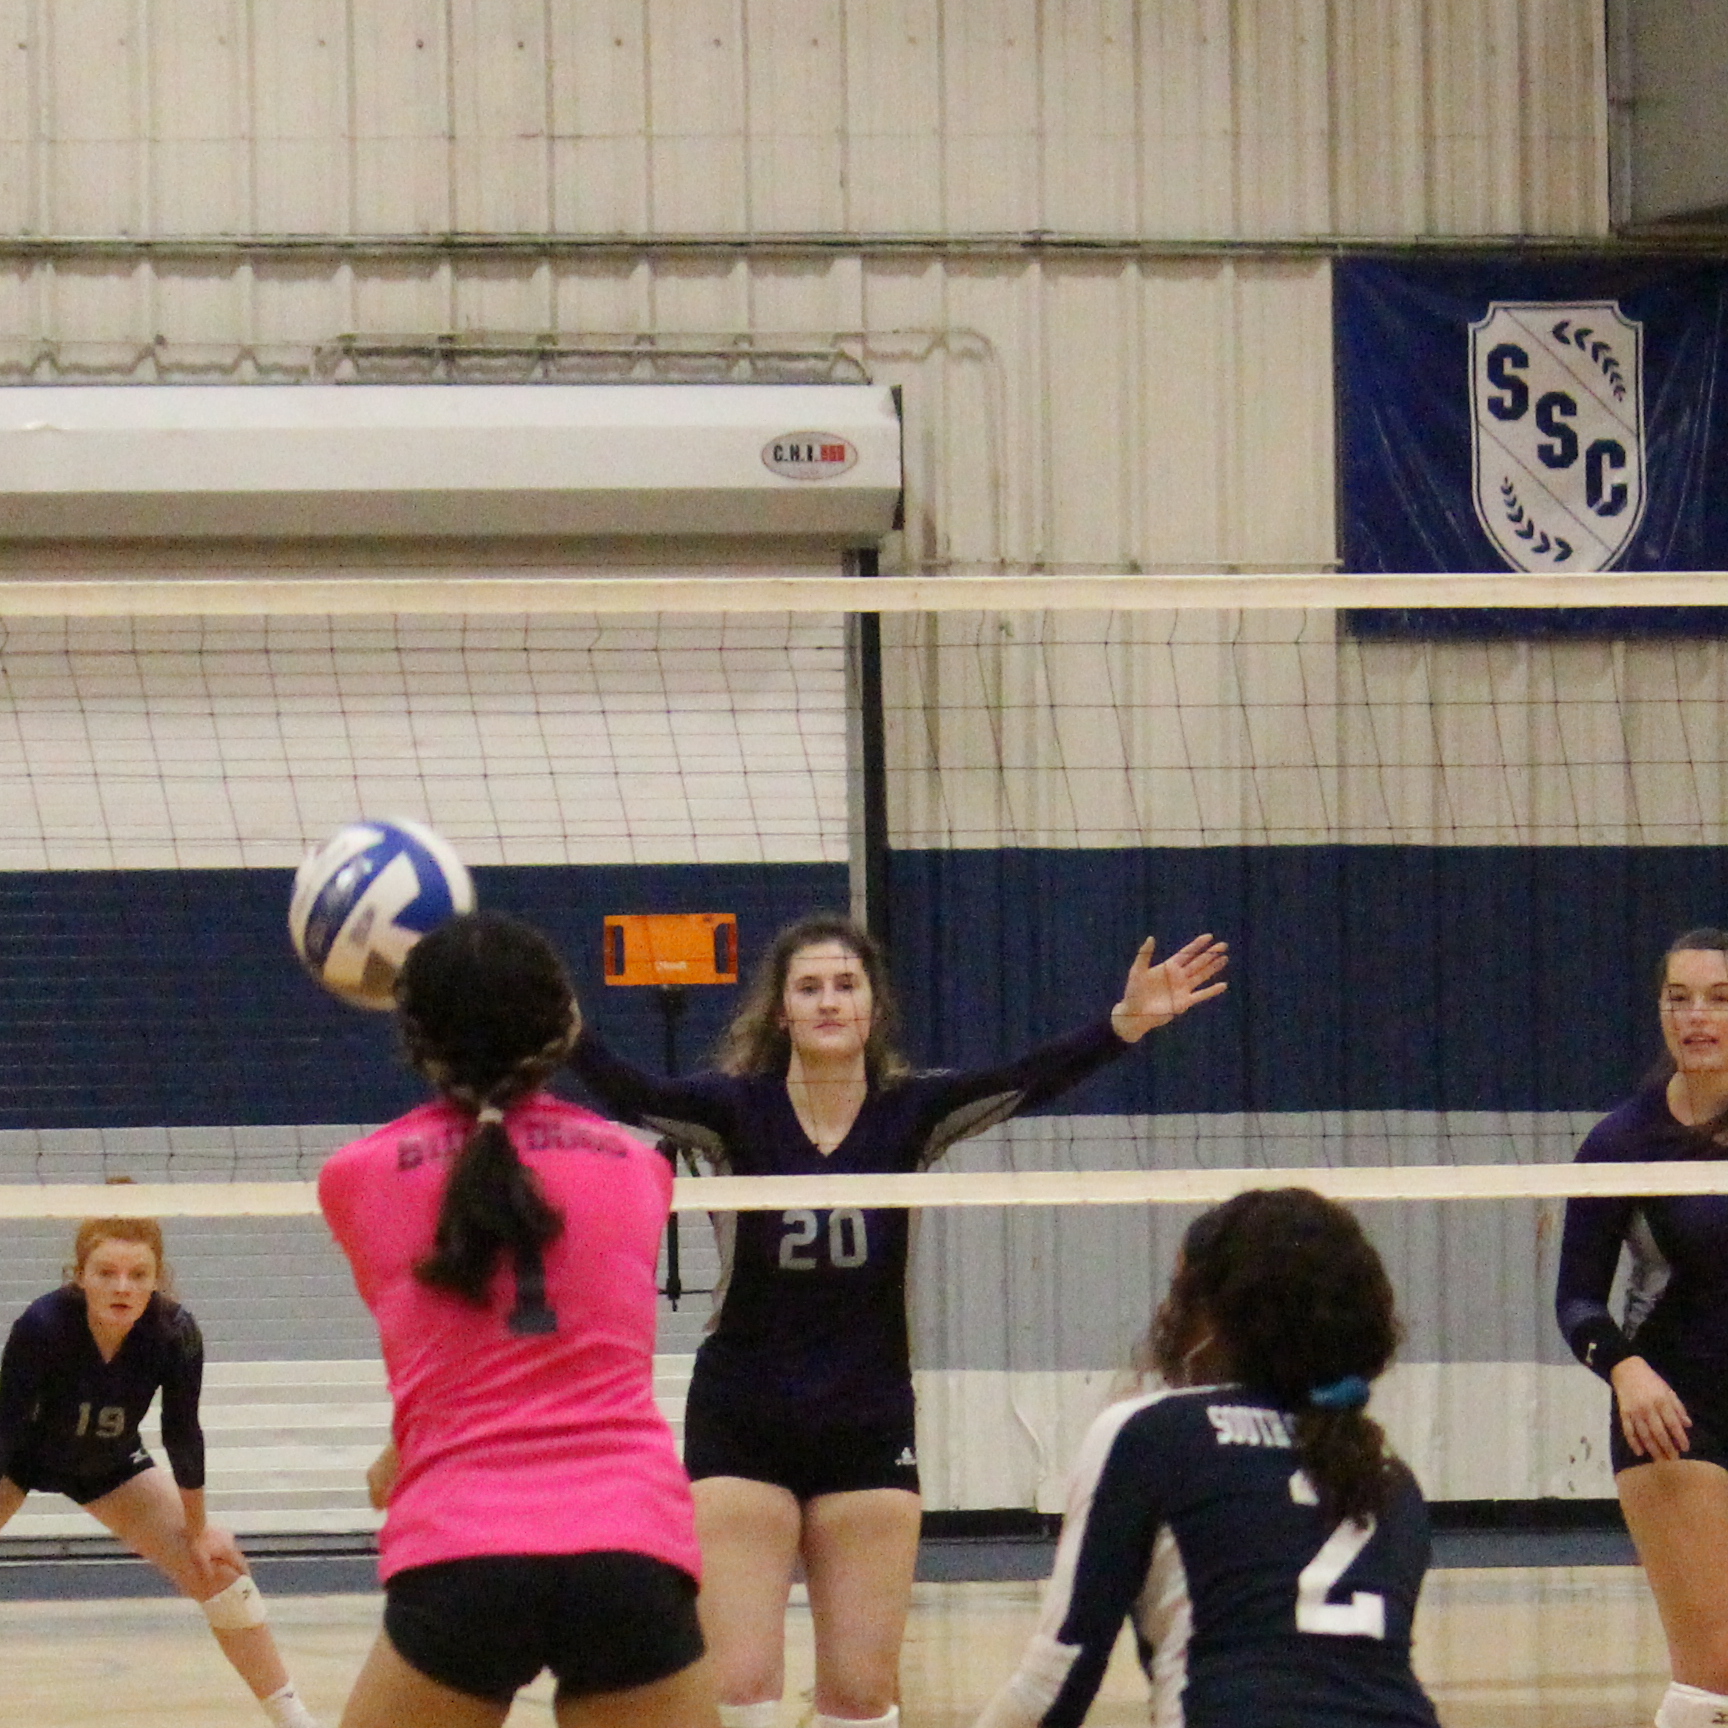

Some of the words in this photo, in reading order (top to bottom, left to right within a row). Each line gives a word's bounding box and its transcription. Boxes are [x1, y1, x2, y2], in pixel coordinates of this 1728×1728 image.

[779, 1208, 868, 1271] 20
[75, 1401, 126, 1439] 19
[1287, 1466, 1386, 1641] 2
